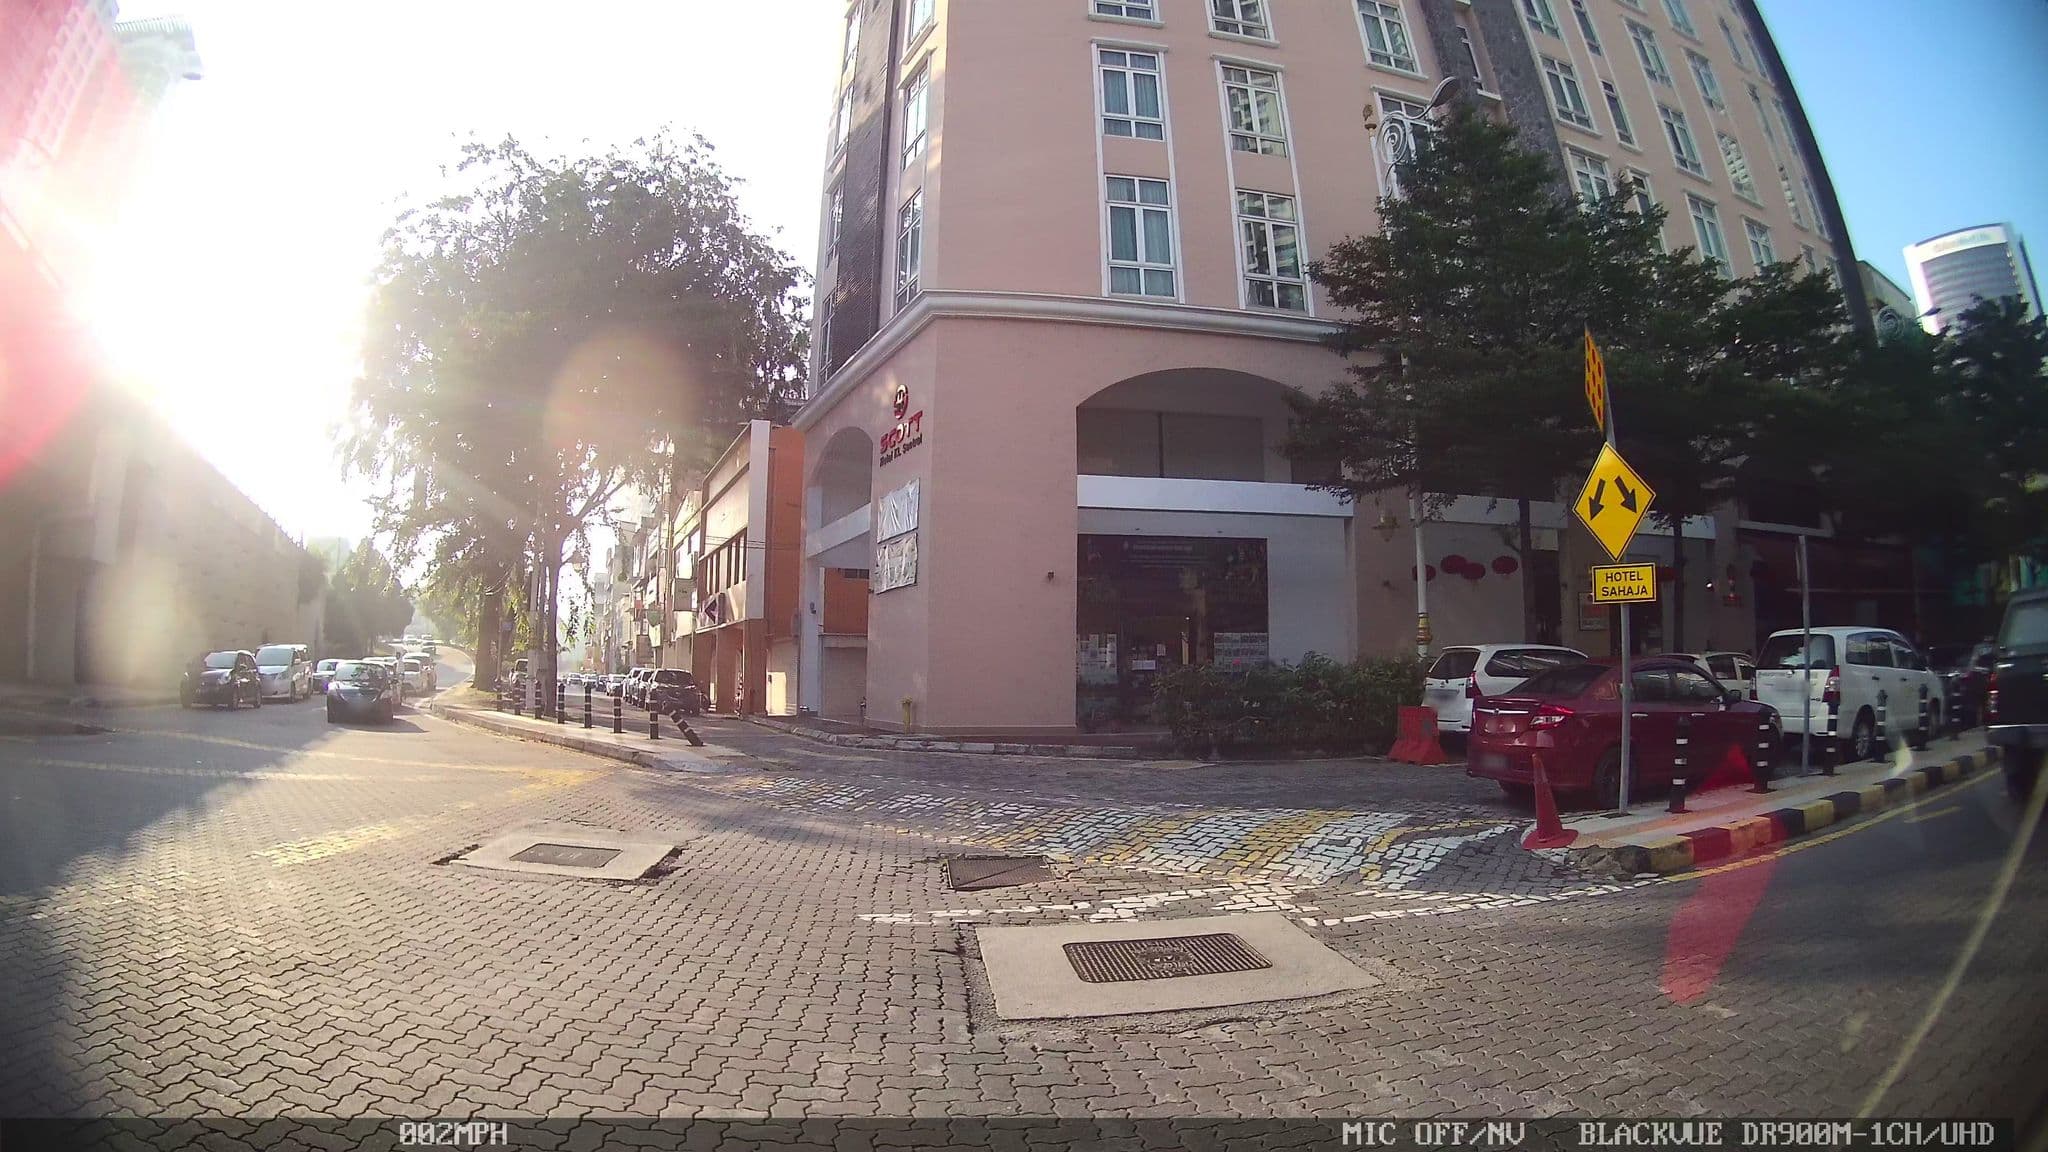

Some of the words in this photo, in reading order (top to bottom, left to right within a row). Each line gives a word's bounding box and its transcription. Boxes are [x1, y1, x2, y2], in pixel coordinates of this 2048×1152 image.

[880, 411, 923, 453] SCOTT
[1605, 571, 1644, 583] HOTEL
[1602, 585, 1648, 597] SAHAJA
